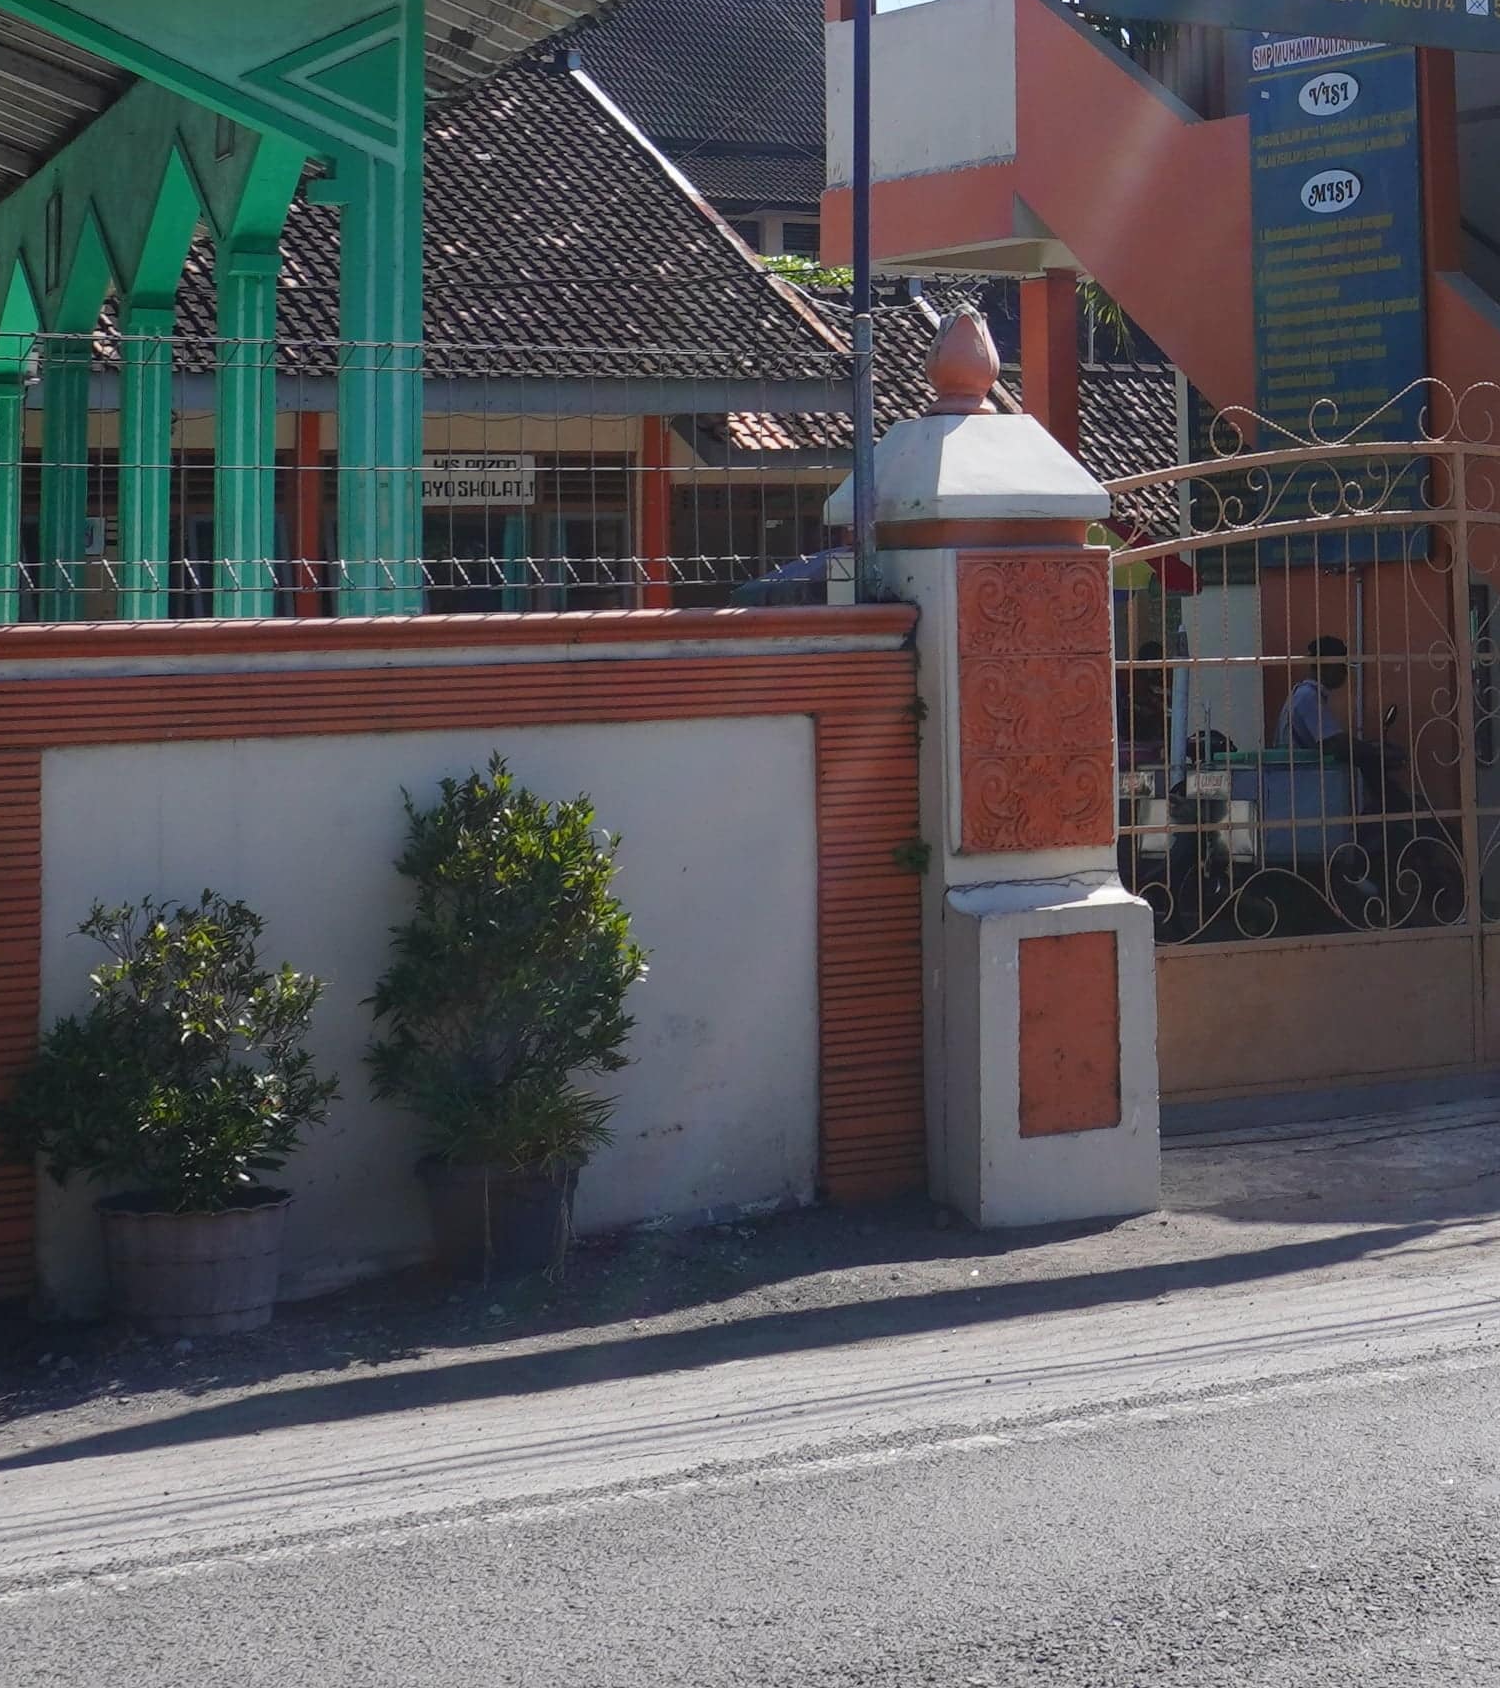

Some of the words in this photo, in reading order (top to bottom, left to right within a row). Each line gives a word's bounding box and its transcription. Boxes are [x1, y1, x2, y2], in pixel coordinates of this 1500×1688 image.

[1253, 46, 1271, 69] SMP
[1309, 81, 1349, 106] VISI
[1308, 184, 1354, 208] MISI
[422, 481, 455, 497] AYO
